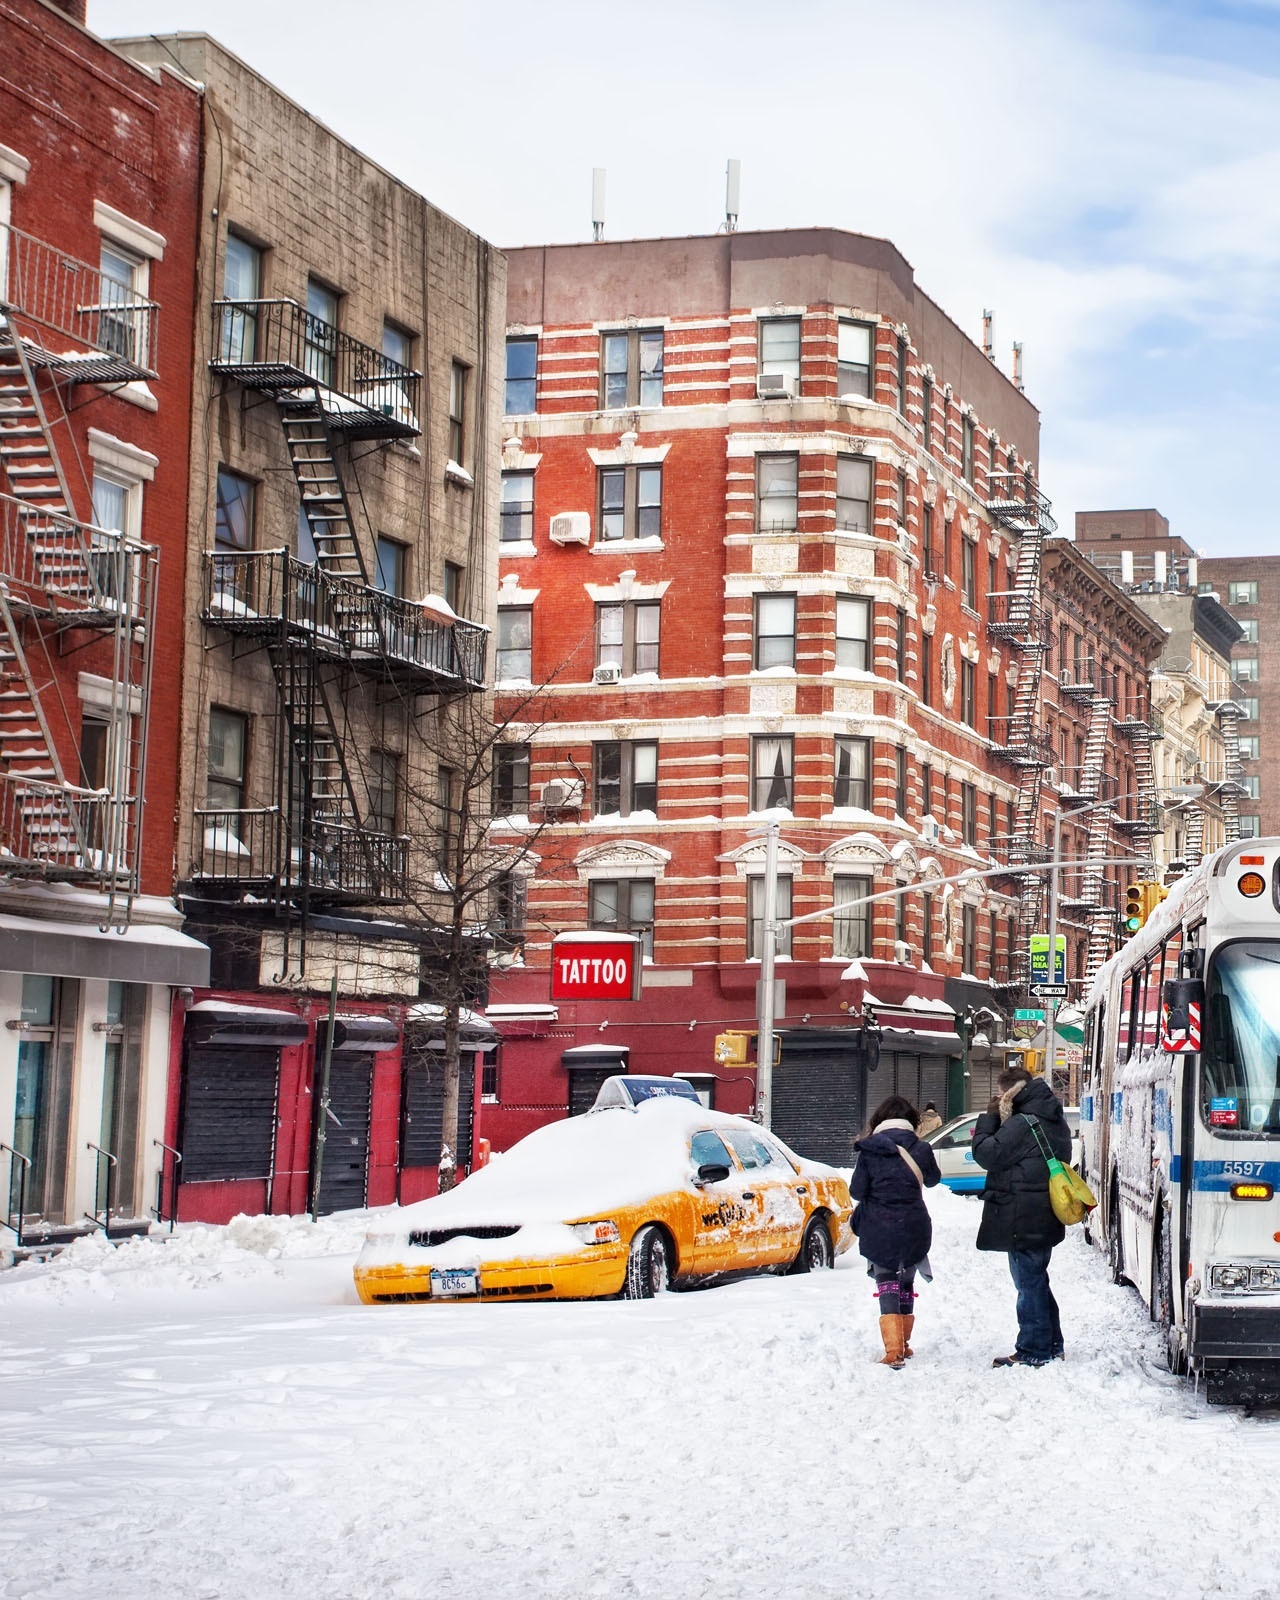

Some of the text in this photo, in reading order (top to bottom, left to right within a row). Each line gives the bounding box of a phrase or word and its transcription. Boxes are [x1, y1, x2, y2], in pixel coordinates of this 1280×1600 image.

[559, 958, 627, 985] TATTOO
[1016, 1010, 1022, 1019] E
[1026, 1010, 1036, 1019] 13
[1223, 1162, 1264, 1176] 5597
